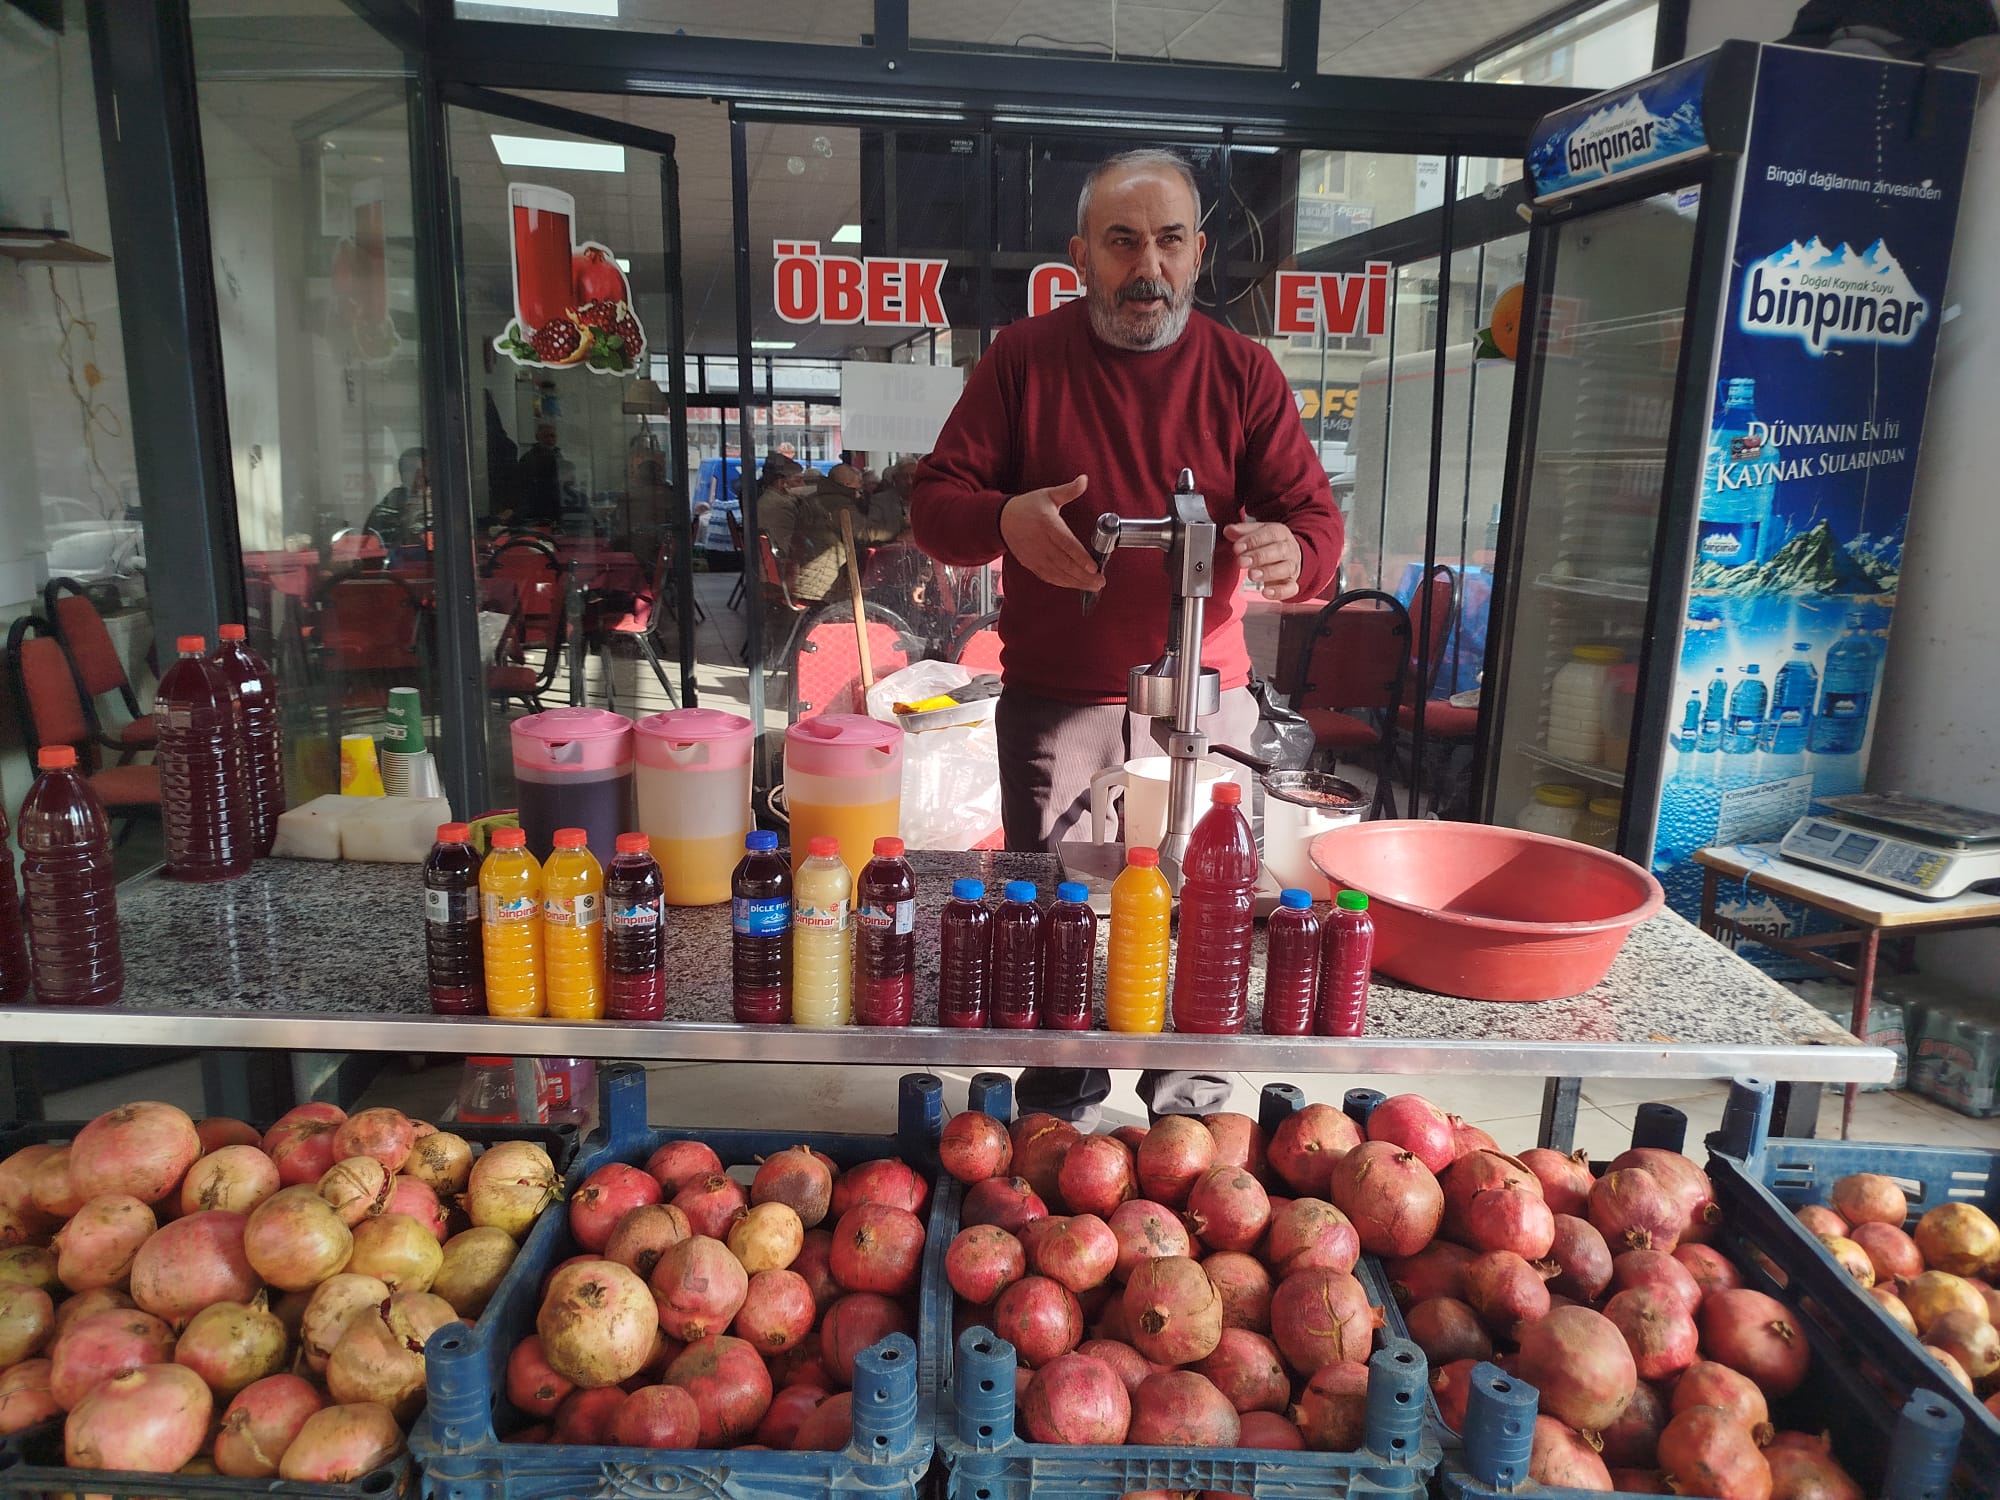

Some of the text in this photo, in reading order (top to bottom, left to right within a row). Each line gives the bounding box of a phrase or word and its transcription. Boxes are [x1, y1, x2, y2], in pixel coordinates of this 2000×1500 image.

[1567, 121, 1655, 173] binpınar
[1766, 165, 1942, 200] Bingöl dağlarının zirvesinden
[774, 240, 950, 328] ÖBEK
[1275, 260, 1392, 337] EVİ
[1799, 274, 1895, 296] Doğal Kaynak Suyu
[1748, 267, 1924, 346] binpınar
[1746, 419, 1858, 449] DÜNYANIN
[1883, 417, 1900, 440] İYİ
[1716, 448, 1906, 492] KAYNAK SULARINDAN
[750, 903, 775, 913] DİCLE
